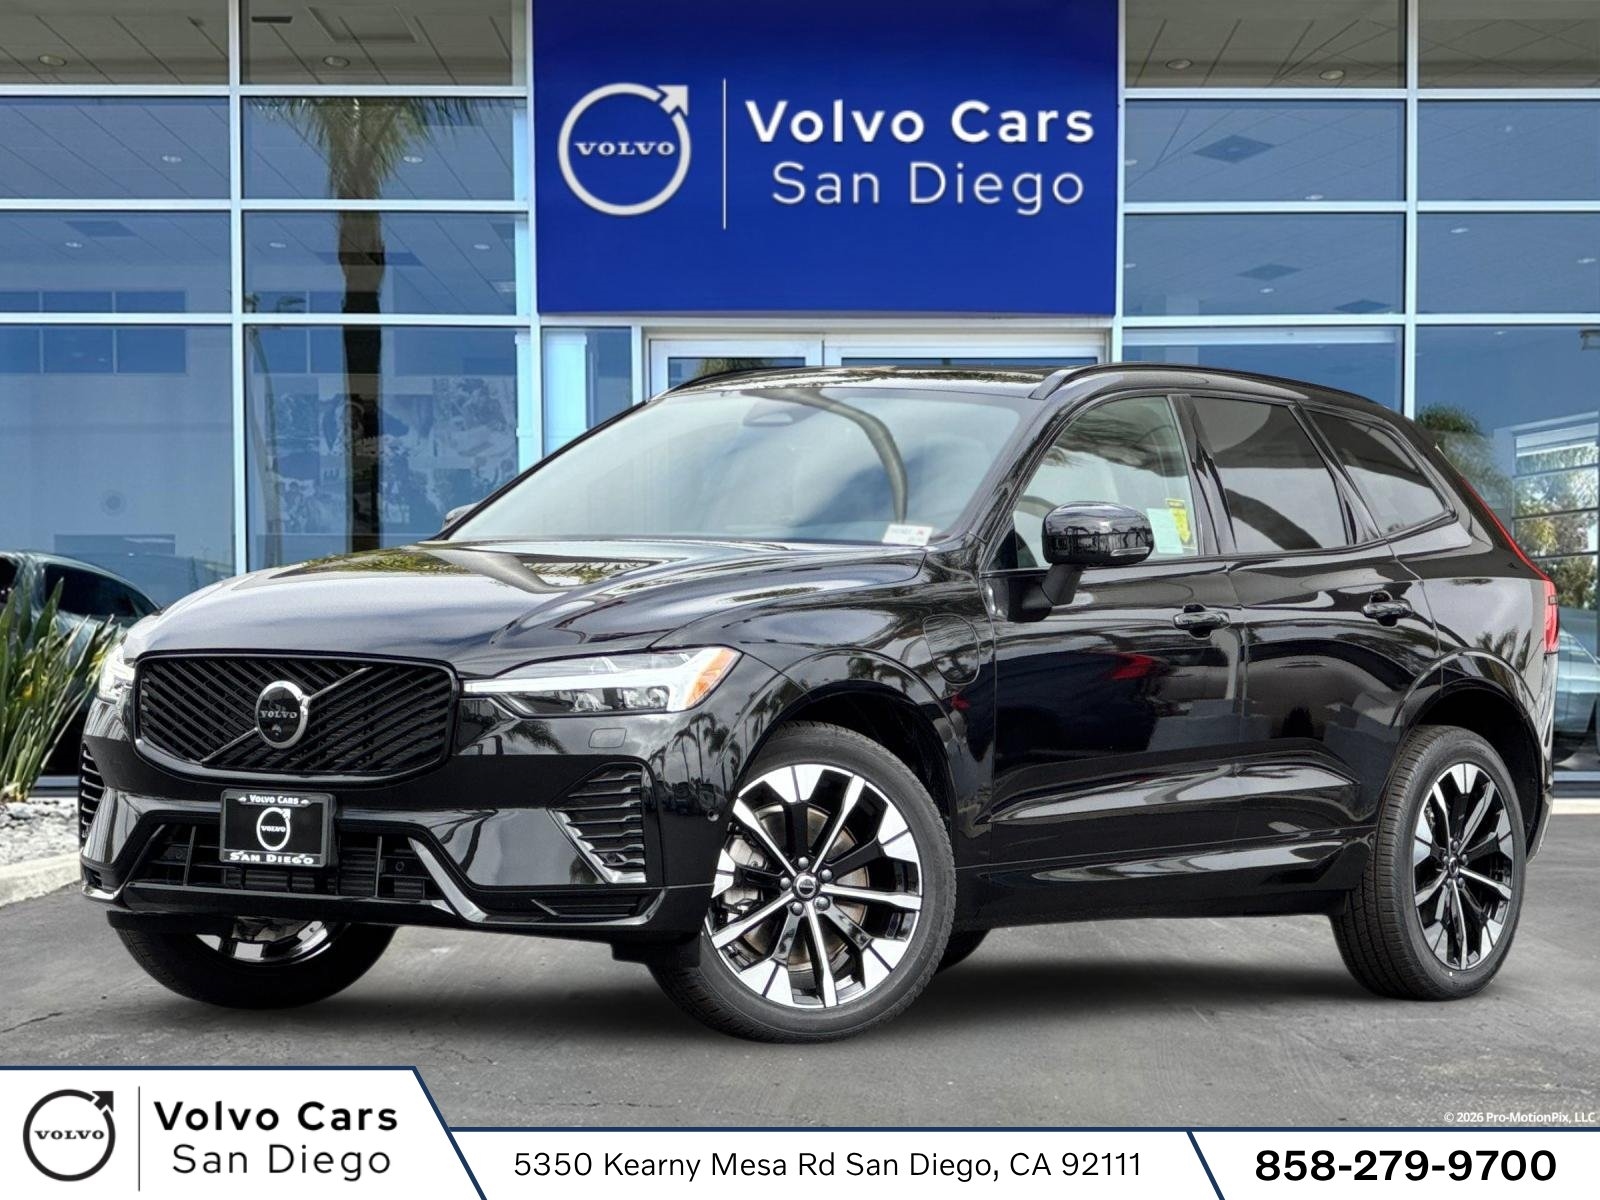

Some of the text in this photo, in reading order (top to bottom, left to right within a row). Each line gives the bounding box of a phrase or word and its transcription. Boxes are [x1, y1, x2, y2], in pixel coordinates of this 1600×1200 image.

[745, 99, 1094, 143] Volvo Cars
[575, 141, 675, 156] VOLVO
[773, 161, 1084, 216] San Diego
[260, 709, 298, 719] VOLVO
